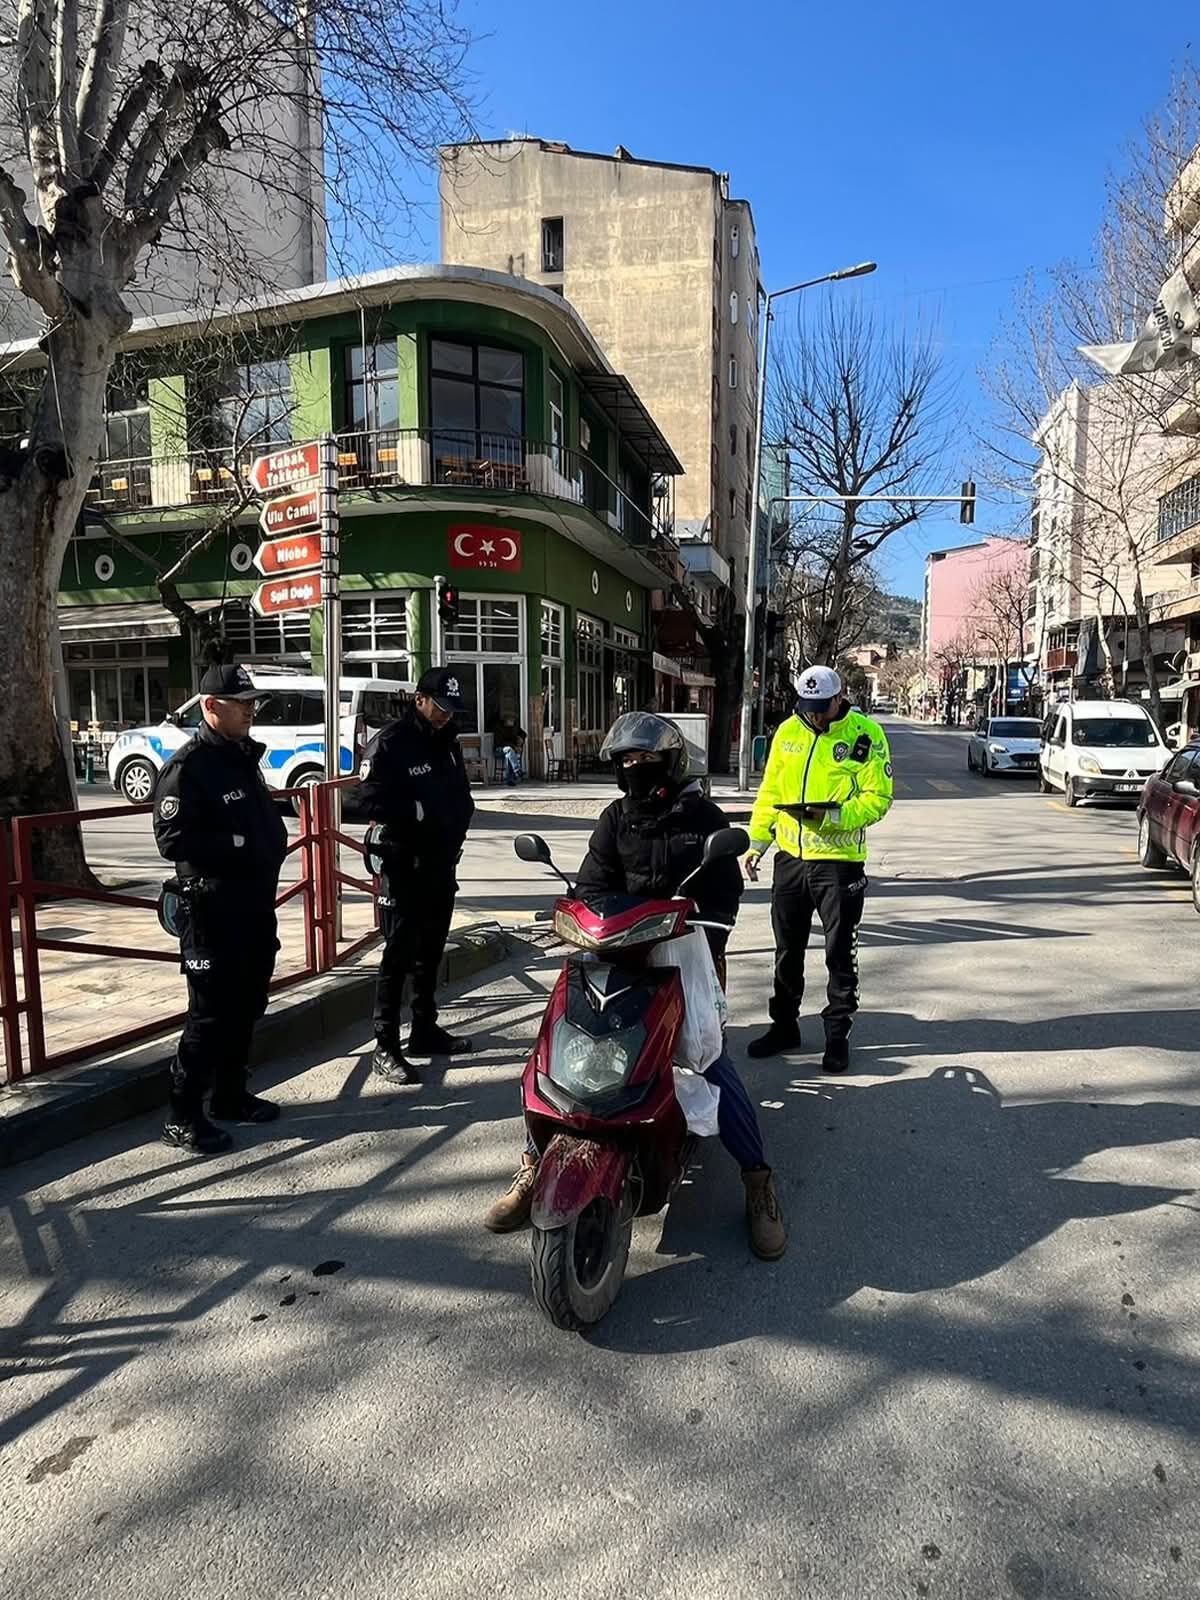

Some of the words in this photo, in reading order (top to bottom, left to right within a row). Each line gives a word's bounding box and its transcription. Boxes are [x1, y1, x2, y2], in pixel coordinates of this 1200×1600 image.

[269, 450, 305, 471] Kabak
[267, 462, 310, 486] Tekkesi
[267, 509, 284, 526] Ulu
[277, 545, 309, 562] Niobe
